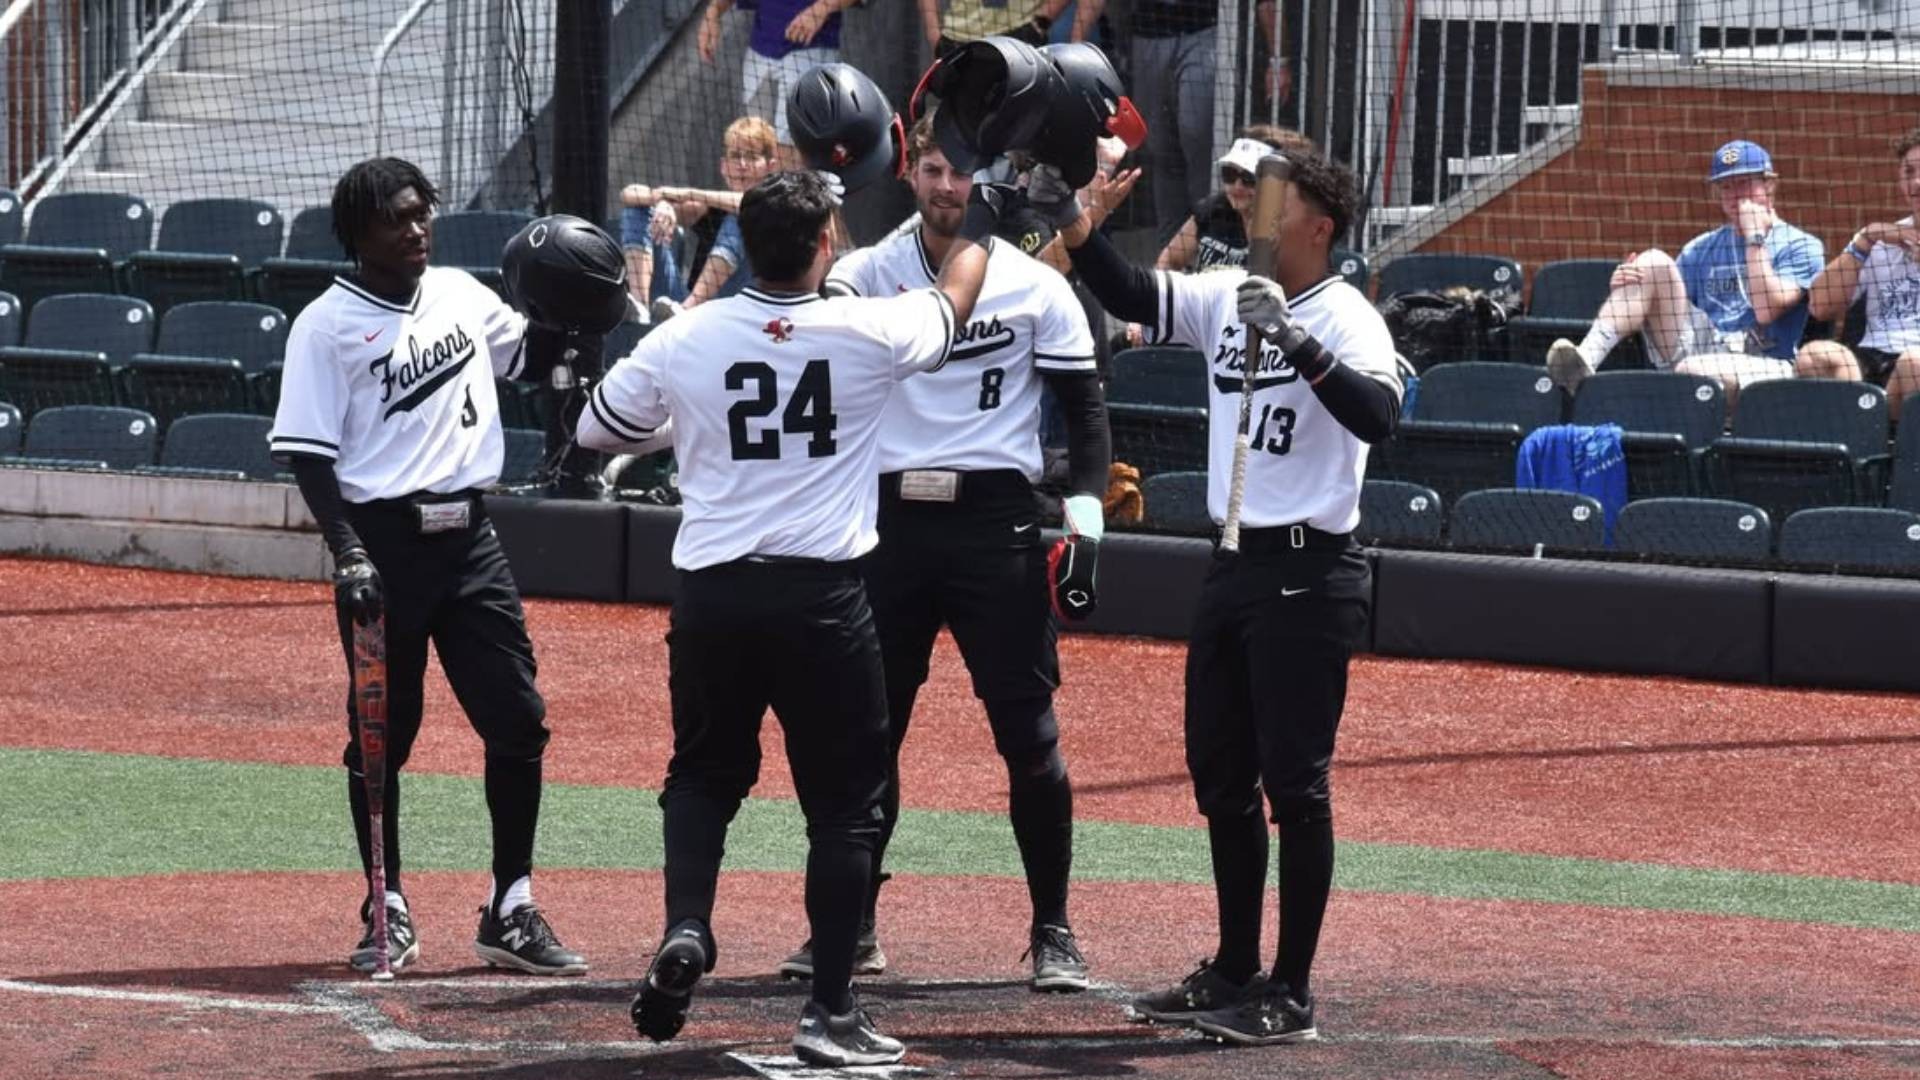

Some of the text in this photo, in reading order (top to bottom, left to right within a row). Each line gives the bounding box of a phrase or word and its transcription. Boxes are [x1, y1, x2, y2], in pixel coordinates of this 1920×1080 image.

[369, 323, 473, 403] Falcons
[978, 367, 1005, 411] 8
[725, 359, 837, 461] 24
[1250, 404, 1297, 456] 13
